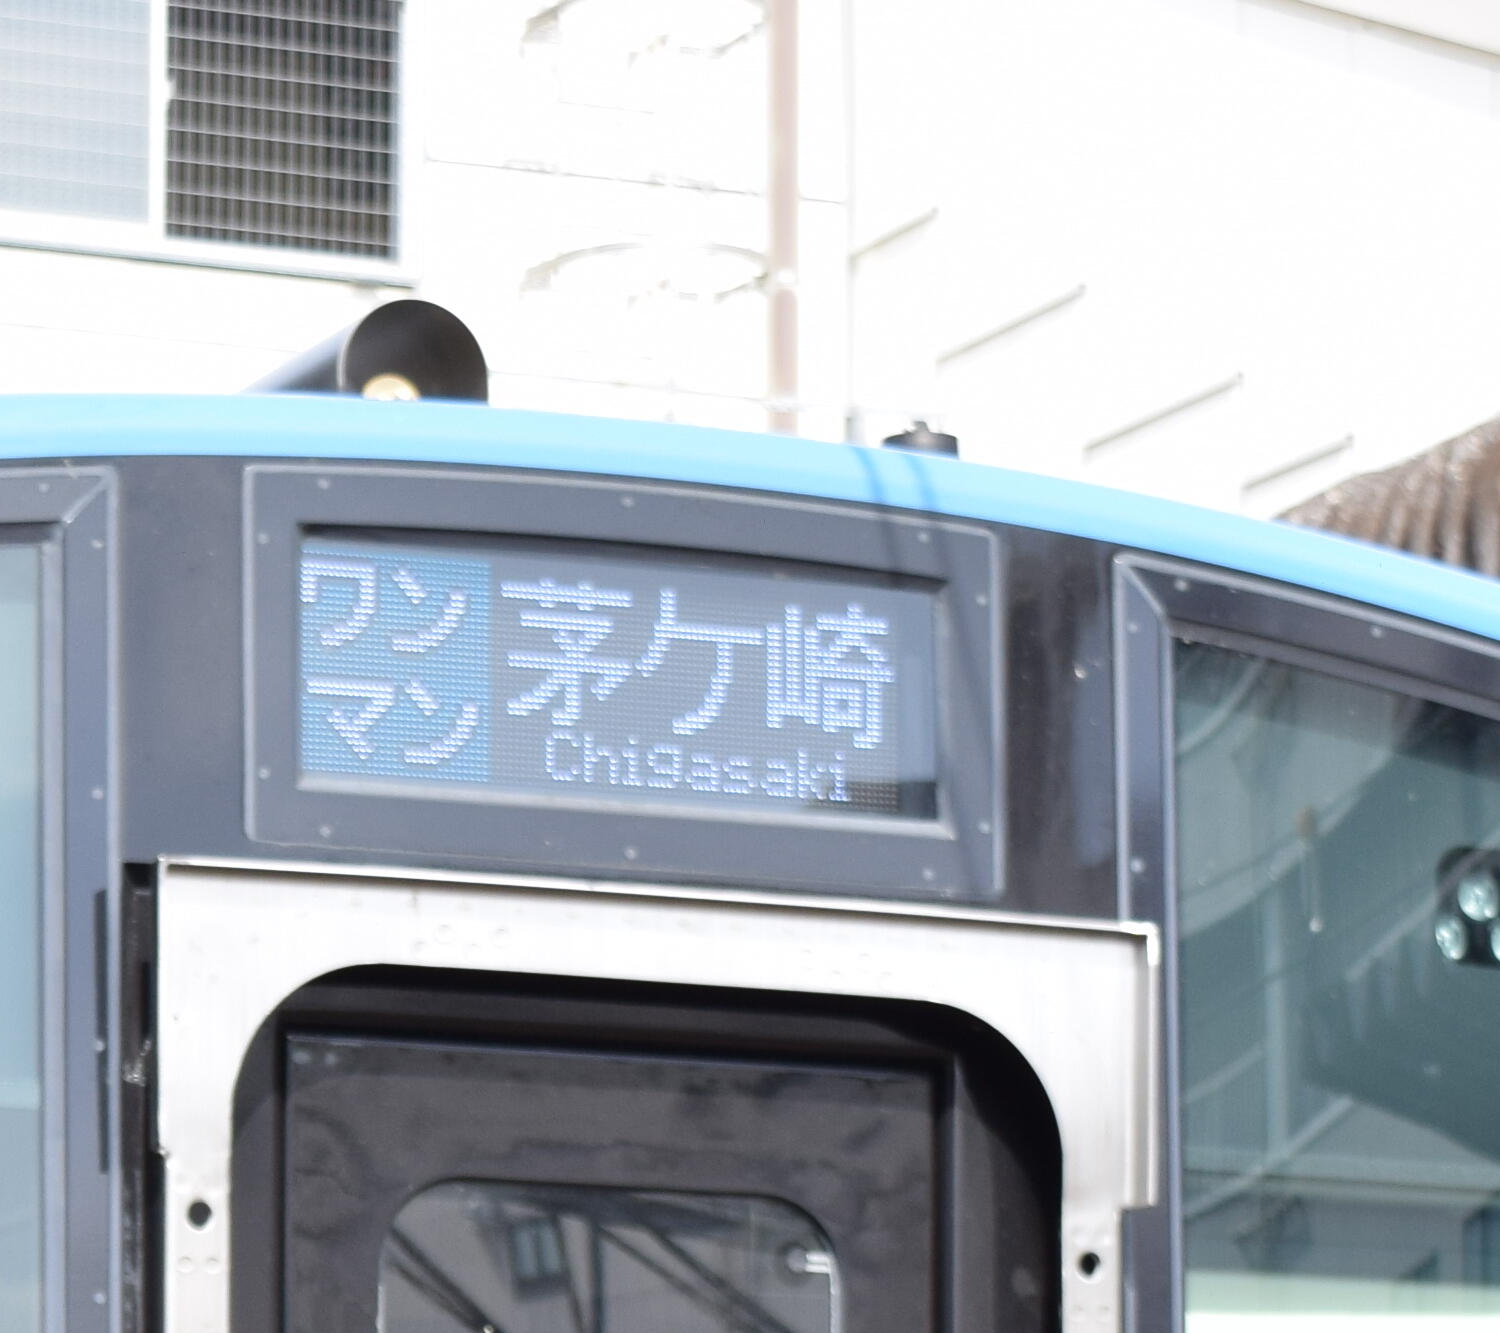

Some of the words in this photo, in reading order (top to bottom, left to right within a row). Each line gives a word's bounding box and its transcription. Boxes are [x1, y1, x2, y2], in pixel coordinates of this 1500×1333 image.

[301, 557, 467, 654] ワン
[306, 676, 479, 766] マン
[545, 733, 850, 803] Chigasaki
